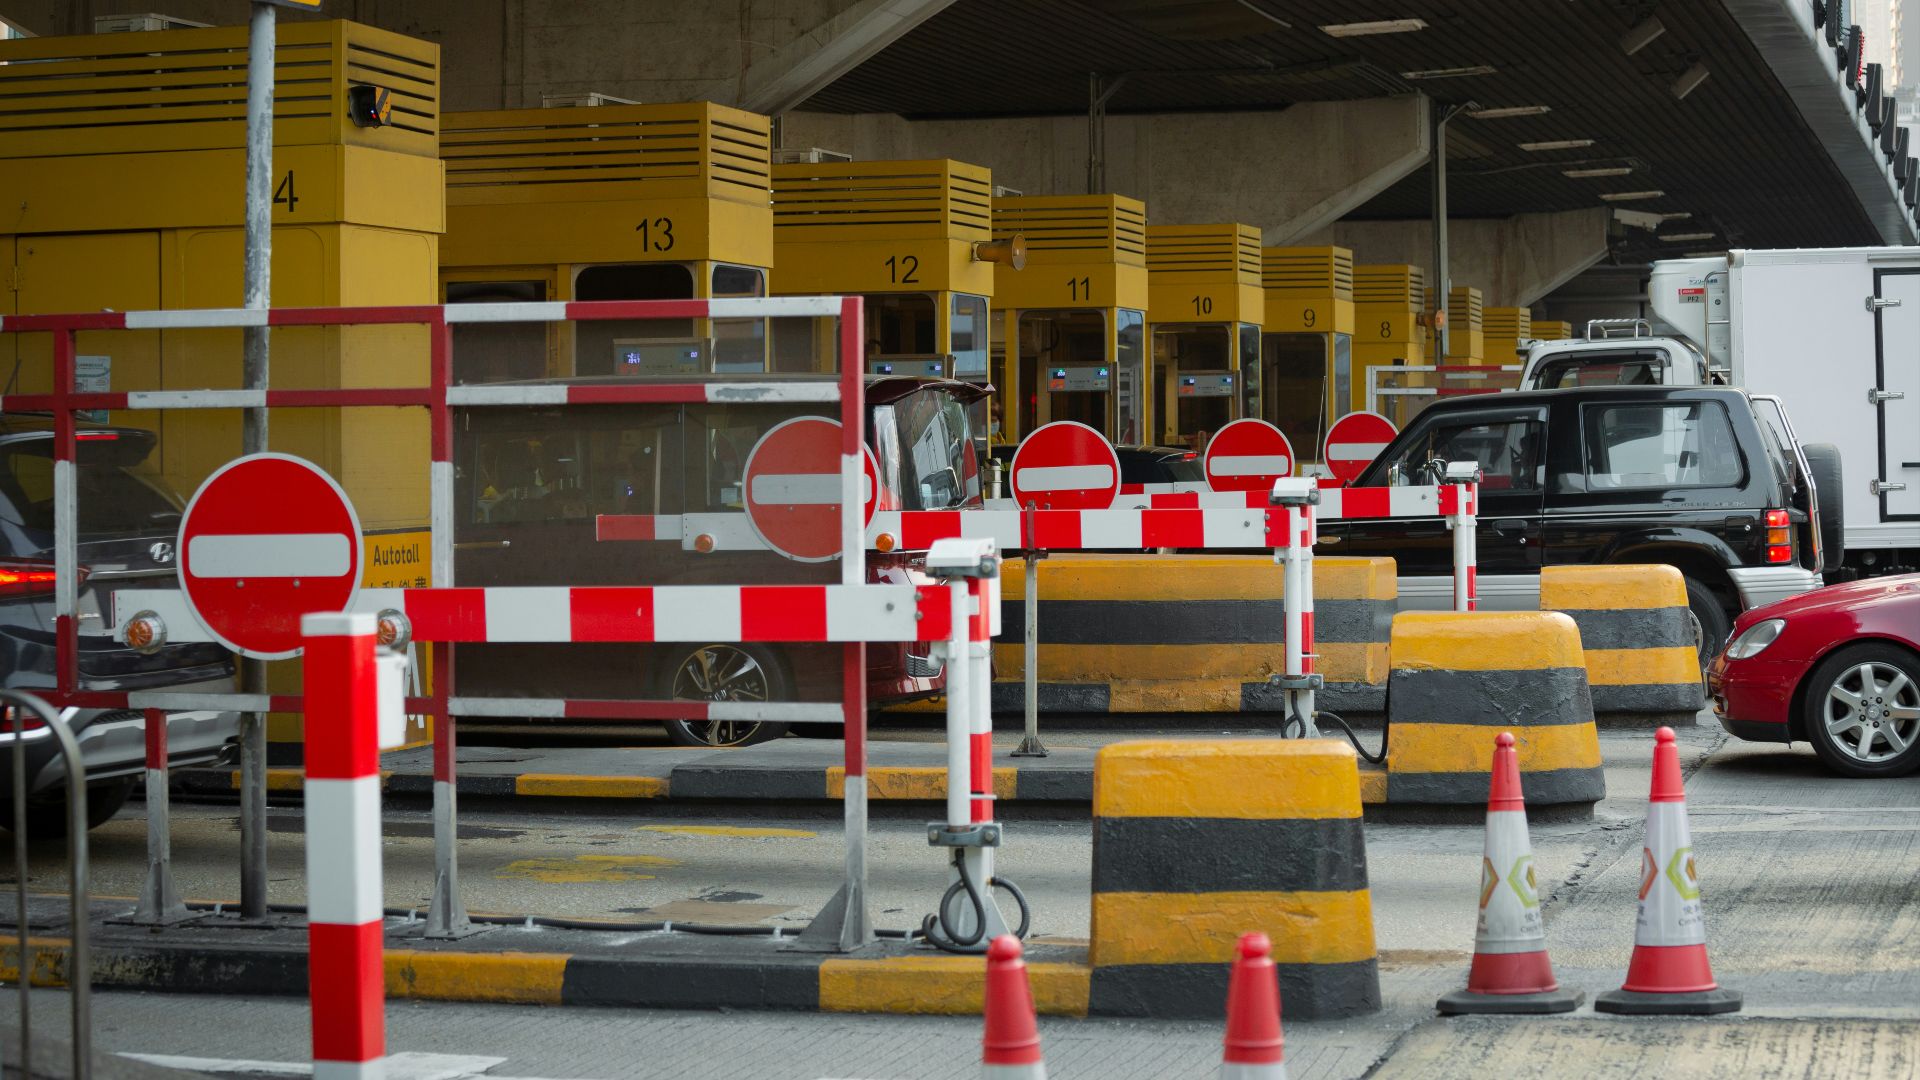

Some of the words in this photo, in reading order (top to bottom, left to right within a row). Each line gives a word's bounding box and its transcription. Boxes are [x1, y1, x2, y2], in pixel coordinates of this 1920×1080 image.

[636, 217, 674, 252] 13
[885, 255, 919, 284] 12
[1067, 276, 1089, 301] 11
[1192, 296, 1212, 317] 10
[1304, 308, 1315, 328] 9
[1380, 321, 1391, 338] 8
[373, 543, 420, 567] Autotoll
